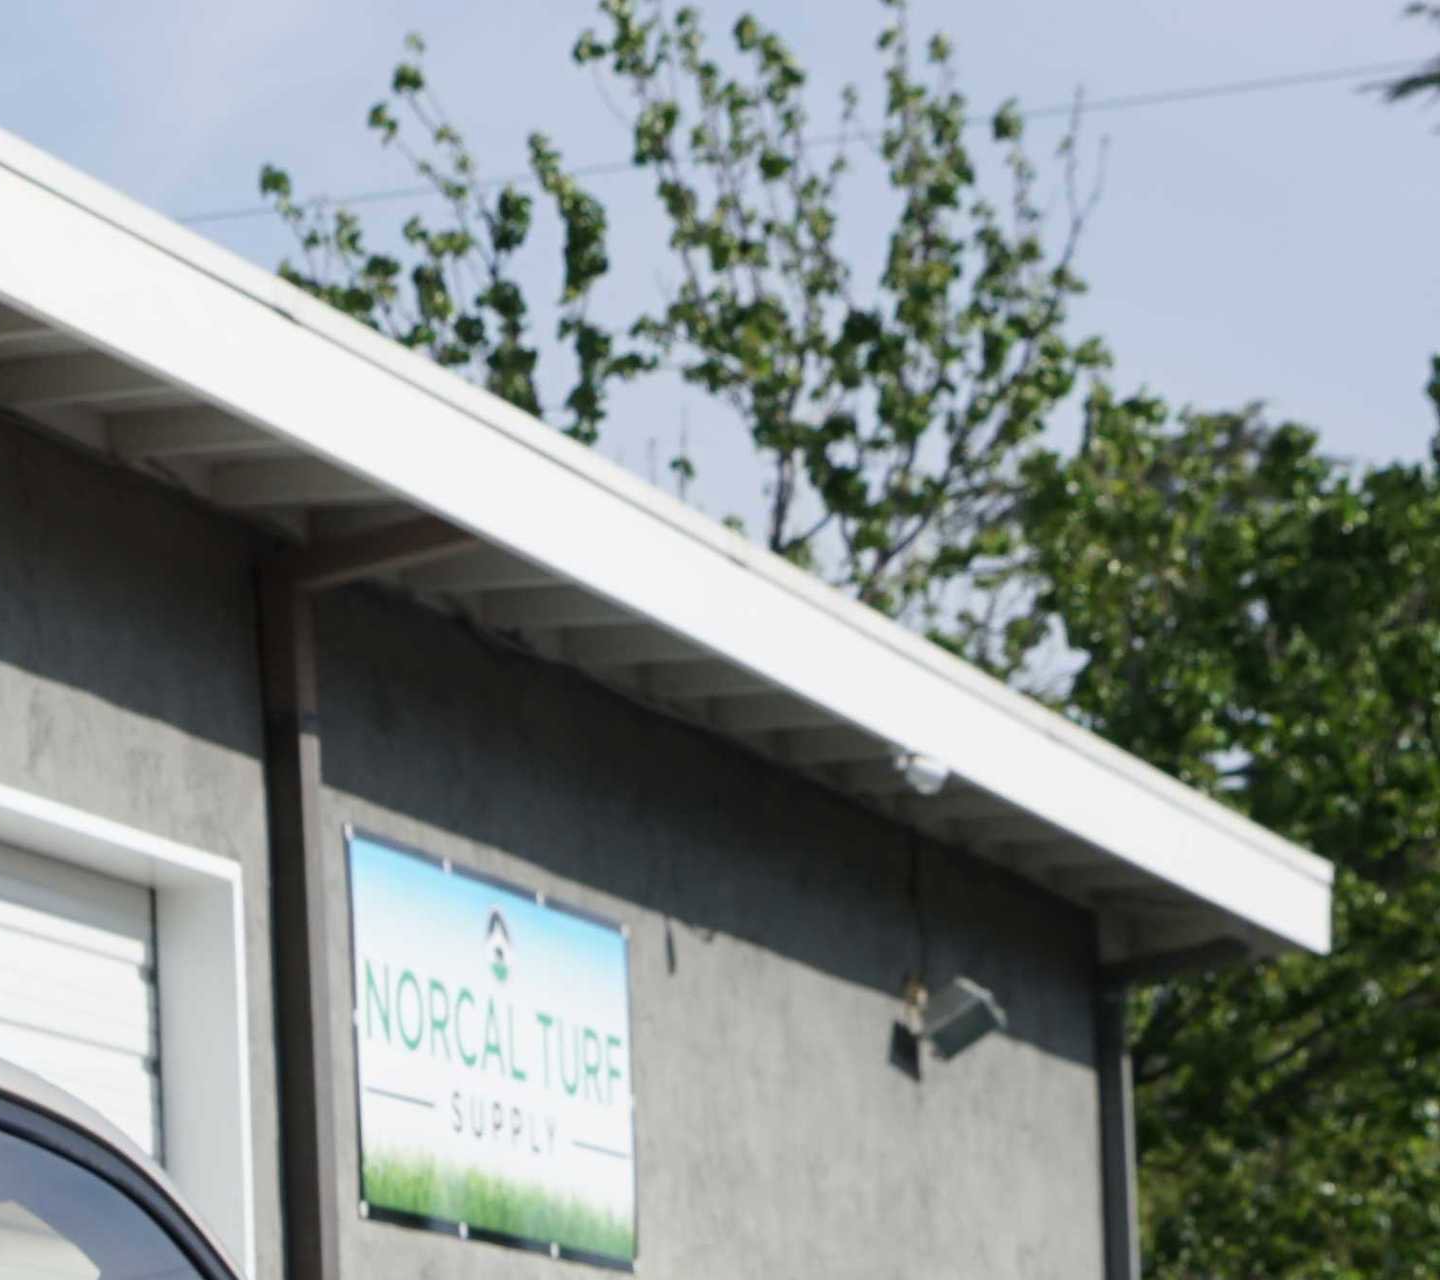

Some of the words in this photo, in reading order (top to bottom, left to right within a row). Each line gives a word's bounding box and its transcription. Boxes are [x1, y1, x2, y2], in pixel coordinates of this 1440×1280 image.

[364, 957, 527, 1081] NORCAL
[537, 1010, 625, 1104] TURF
[452, 1090, 557, 1154] SUPPLY
